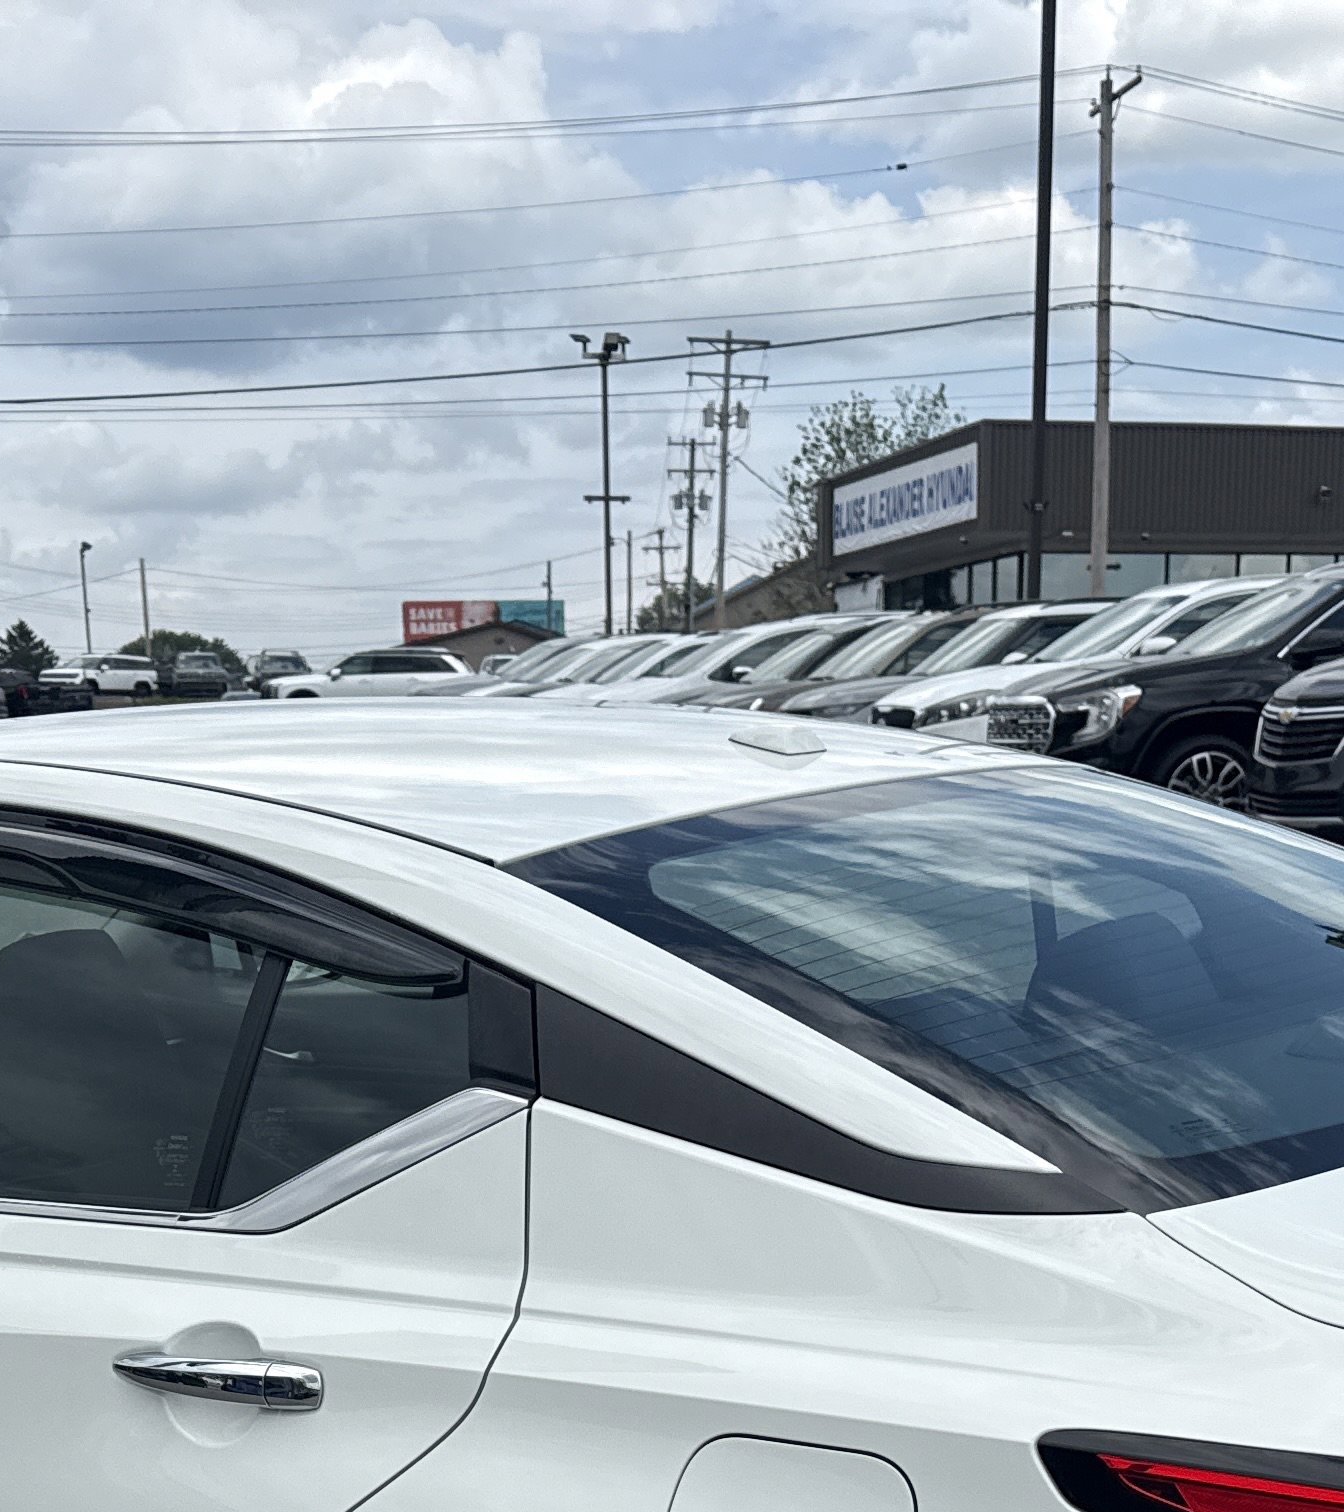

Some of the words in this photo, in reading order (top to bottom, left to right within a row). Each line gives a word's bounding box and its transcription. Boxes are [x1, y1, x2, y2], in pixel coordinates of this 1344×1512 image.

[834, 496, 865, 540] BLAISE
[867, 477, 925, 530] ALEXANDER
[408, 607, 443, 621] SAVE
